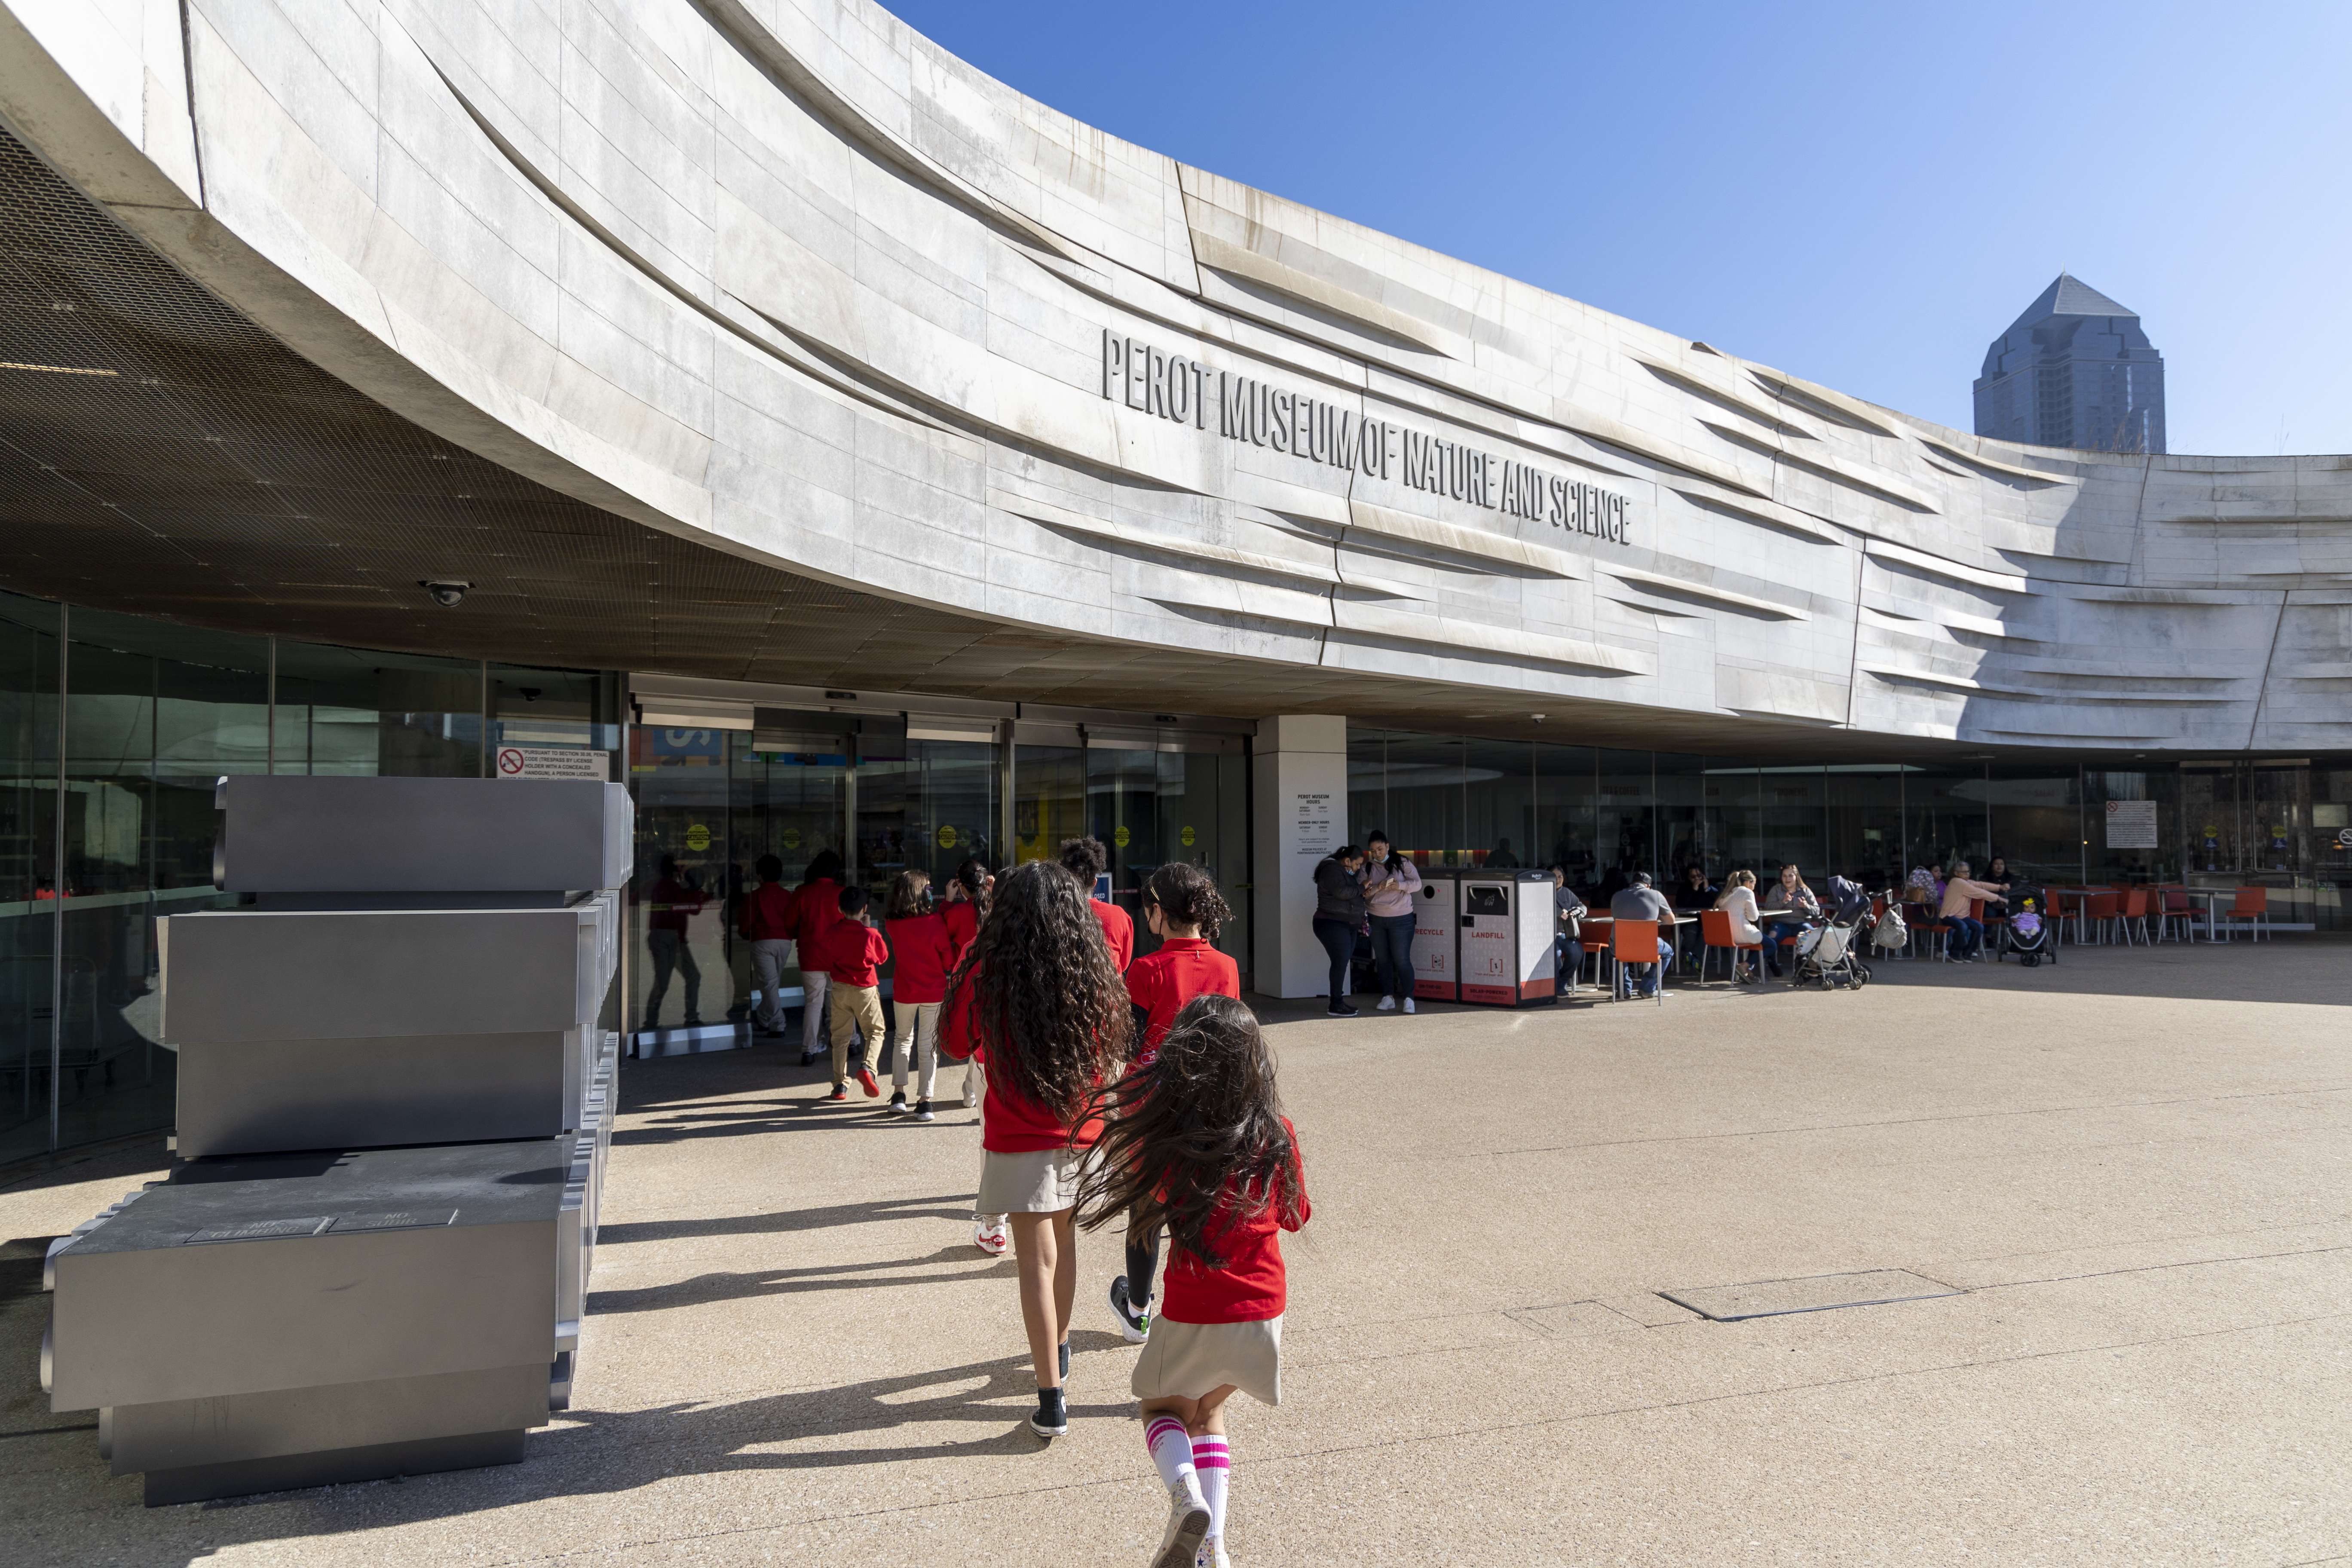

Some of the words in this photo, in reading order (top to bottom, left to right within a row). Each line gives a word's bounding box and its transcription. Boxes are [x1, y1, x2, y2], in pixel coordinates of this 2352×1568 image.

[1102, 328, 1212, 431] PEROT
[1219, 371, 1355, 471] MUSEUM
[1360, 416, 1398, 481] OF
[1404, 428, 1497, 510] NATURE
[1501, 459, 1545, 522] AND
[1549, 474, 1632, 545] SCIENCE
[365, 1218, 417, 1227] SUBIR
[211, 1226, 299, 1238] CLIMBING
